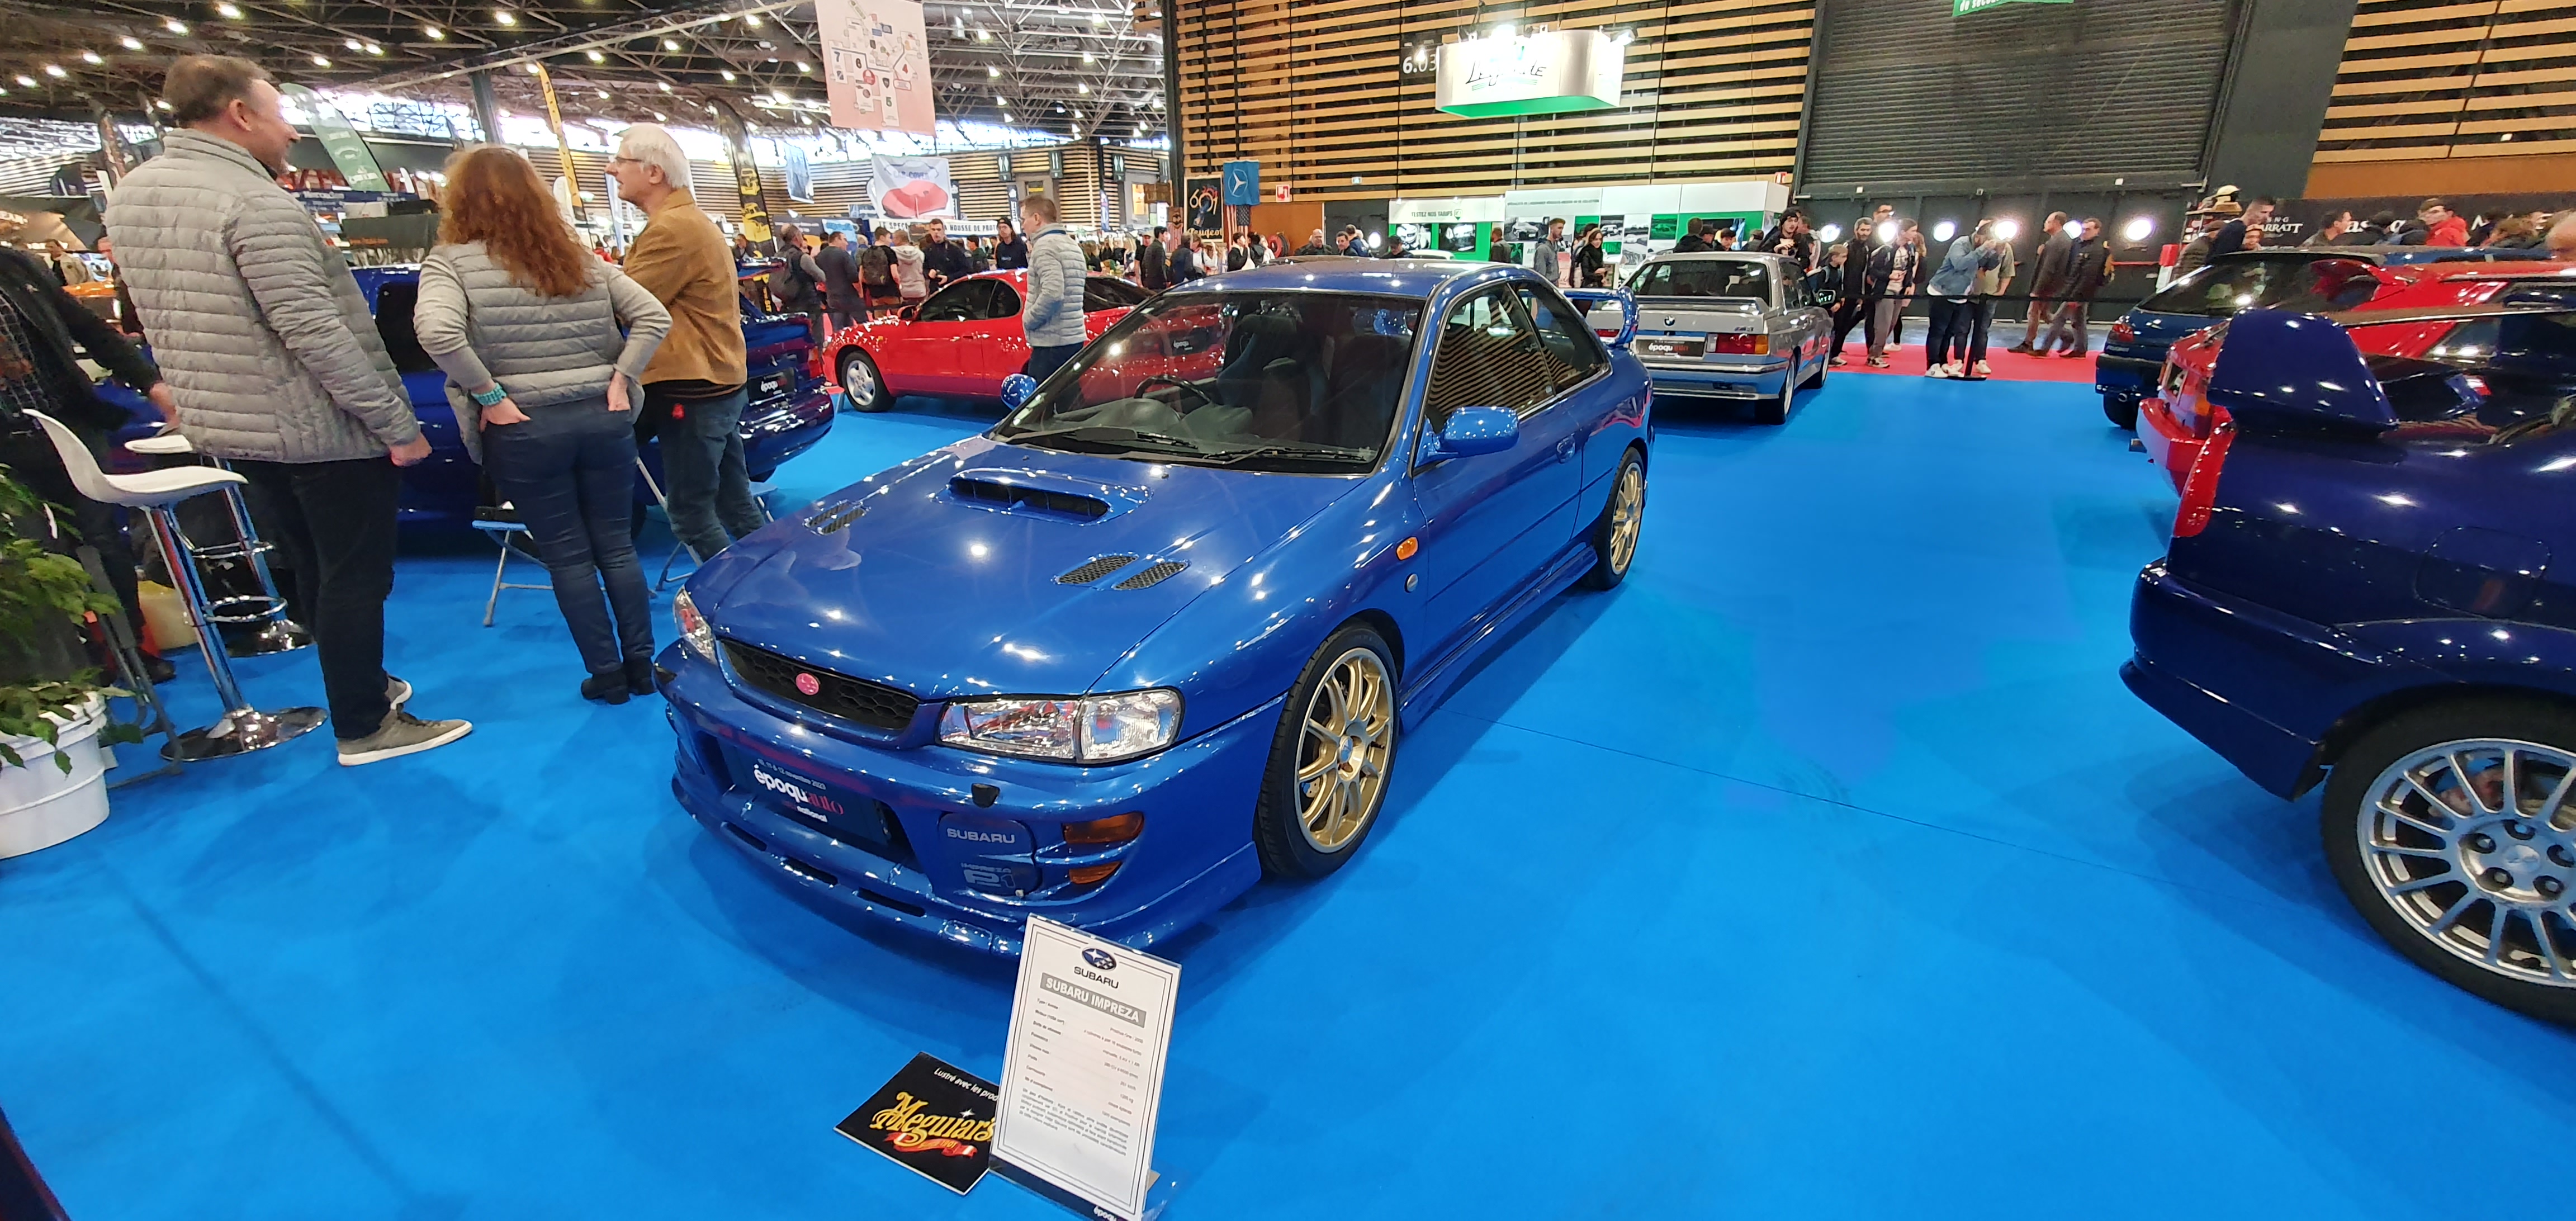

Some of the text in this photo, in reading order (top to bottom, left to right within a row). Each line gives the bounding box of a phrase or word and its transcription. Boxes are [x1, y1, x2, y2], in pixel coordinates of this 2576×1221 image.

[1403, 54, 1436, 74] 6.03
[886, 97, 892, 107] 5
[1190, 189, 1218, 215] 601
[946, 827, 1015, 844] SUBARU
[963, 869, 1016, 888] P1
[1073, 966, 1119, 989] SUBARU
[1045, 977, 1090, 1004] SUBARU
[1091, 994, 1140, 1023] IMPREZA
[954, 1077, 973, 1090] avec
[970, 1083, 981, 1094] les
